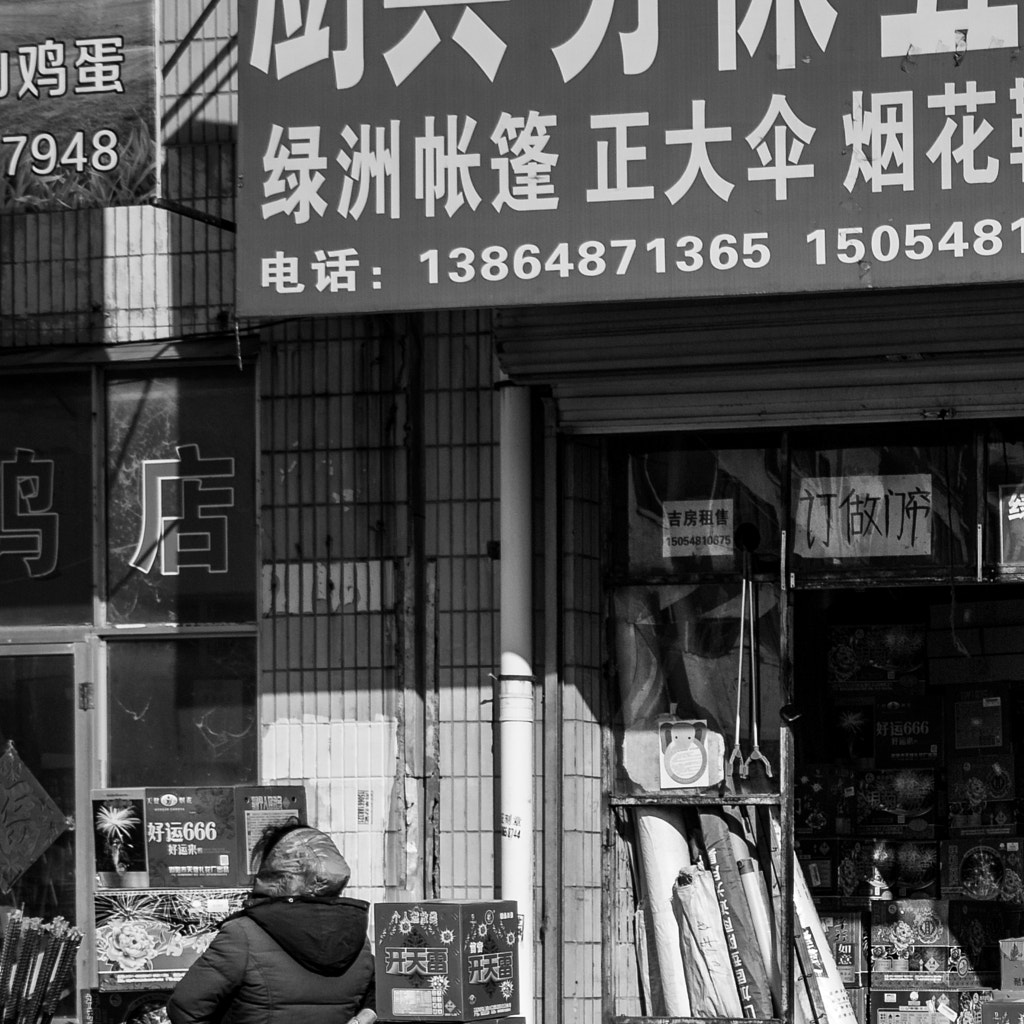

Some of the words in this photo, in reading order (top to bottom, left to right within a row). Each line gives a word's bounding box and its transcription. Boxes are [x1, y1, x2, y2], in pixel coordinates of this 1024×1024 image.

[0, 37, 125, 99] 鸡蛋
[2, 130, 119, 177] 7948
[261, 110, 560, 224] 绿洲帐篷
[586, 93, 817, 206] 正大伞
[419, 232, 772, 284] 13864871365
[668, 508, 729, 527] 吉房租售
[666, 534, 731, 547] 15054810675
[147, 821, 218, 843] 好运666
[384, 946, 449, 976] 开天雷
[467, 951, 514, 984] 开天雷
